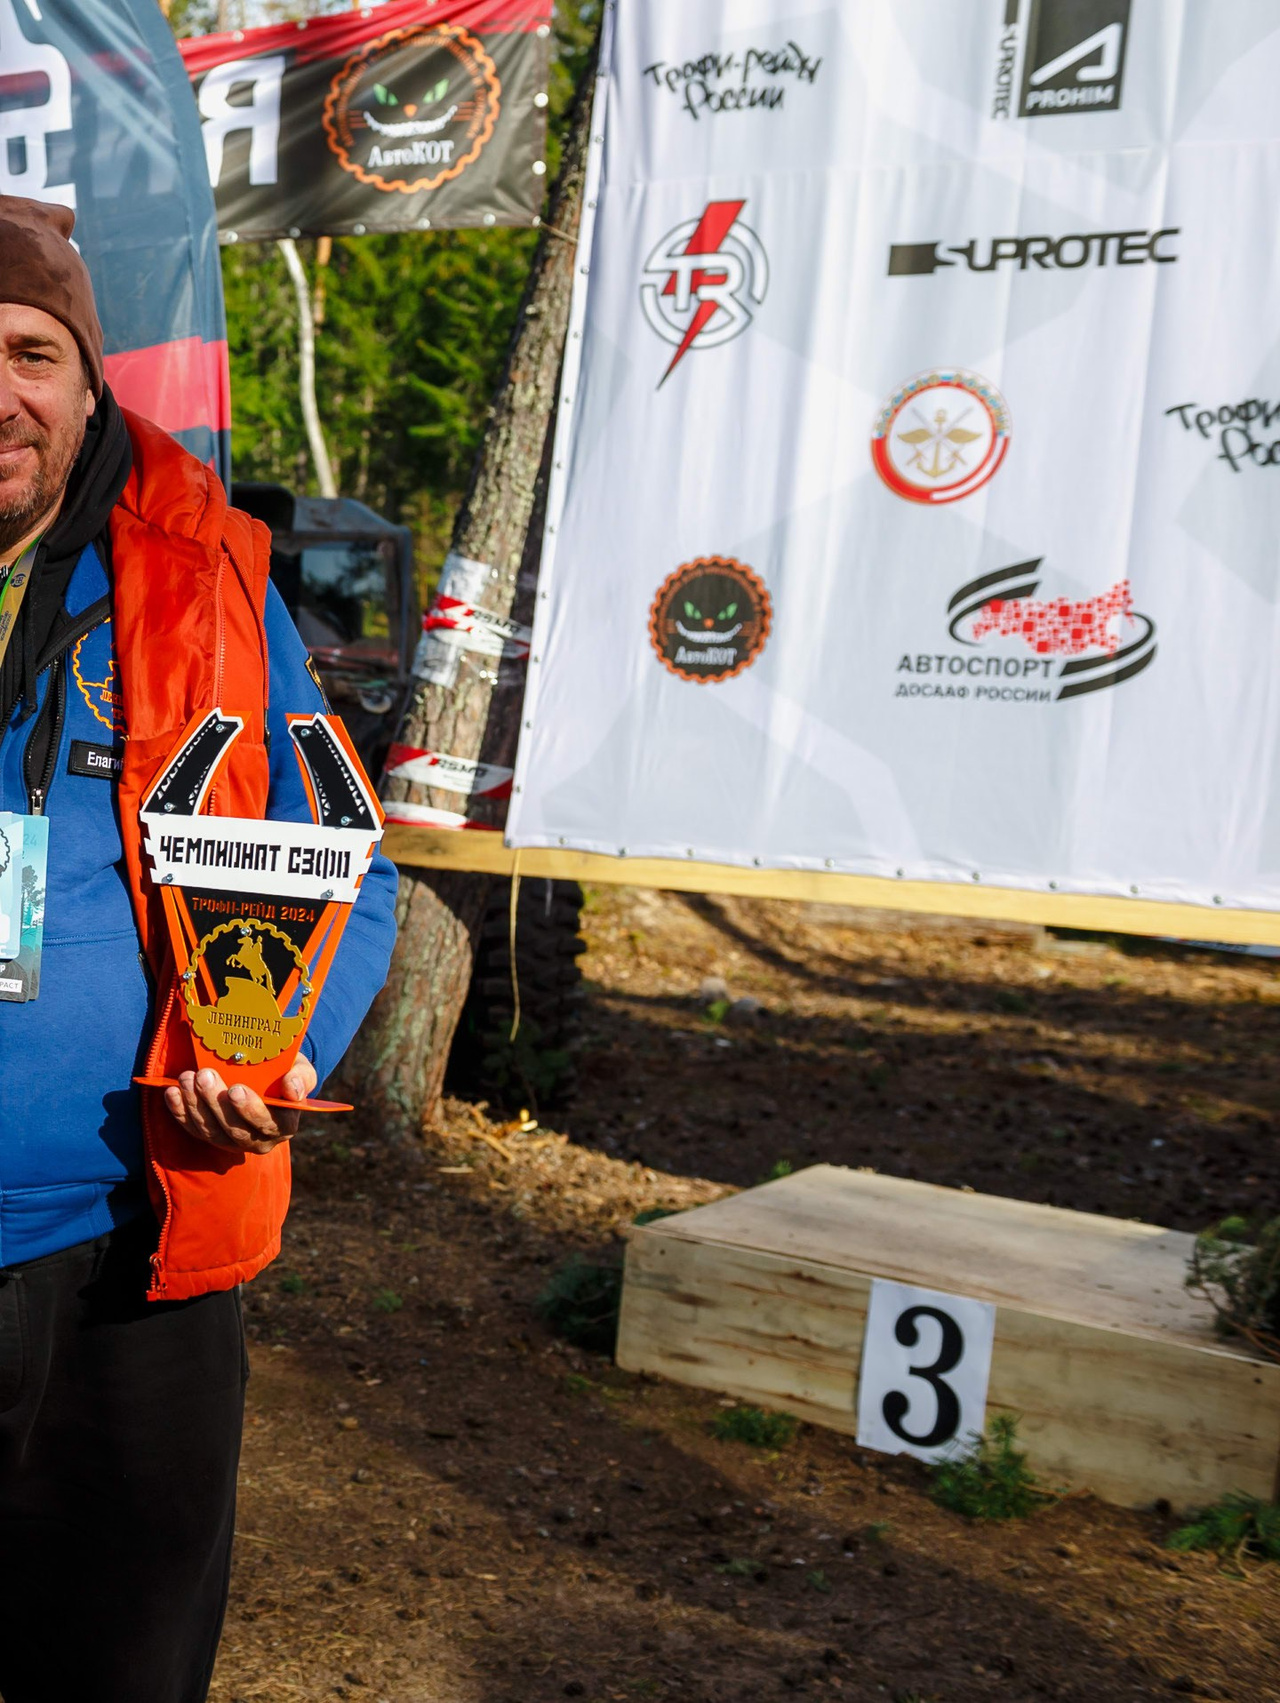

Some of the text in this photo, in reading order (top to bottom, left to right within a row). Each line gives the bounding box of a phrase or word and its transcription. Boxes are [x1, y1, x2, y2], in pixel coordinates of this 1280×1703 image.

[682, 78, 786, 121] России
[1024, 83, 1116, 111] PROHIM
[367, 139, 455, 168] АвтоКОТ
[933, 227, 1183, 273] SUPROTEC
[897, 653, 1055, 679] АВТОСПОРТ
[894, 683, 1052, 702] ДОСААФ РОССИИ
[159, 835, 282, 872] ЧЕМПИОНАТ
[192, 897, 315, 923] ТРОФИ-РЕЙД 2024
[207, 1011, 281, 1037] ЛЕНИНГРАД
[222, 1031, 264, 1050] ТРОФИ
[881, 1304, 965, 1448] 3
